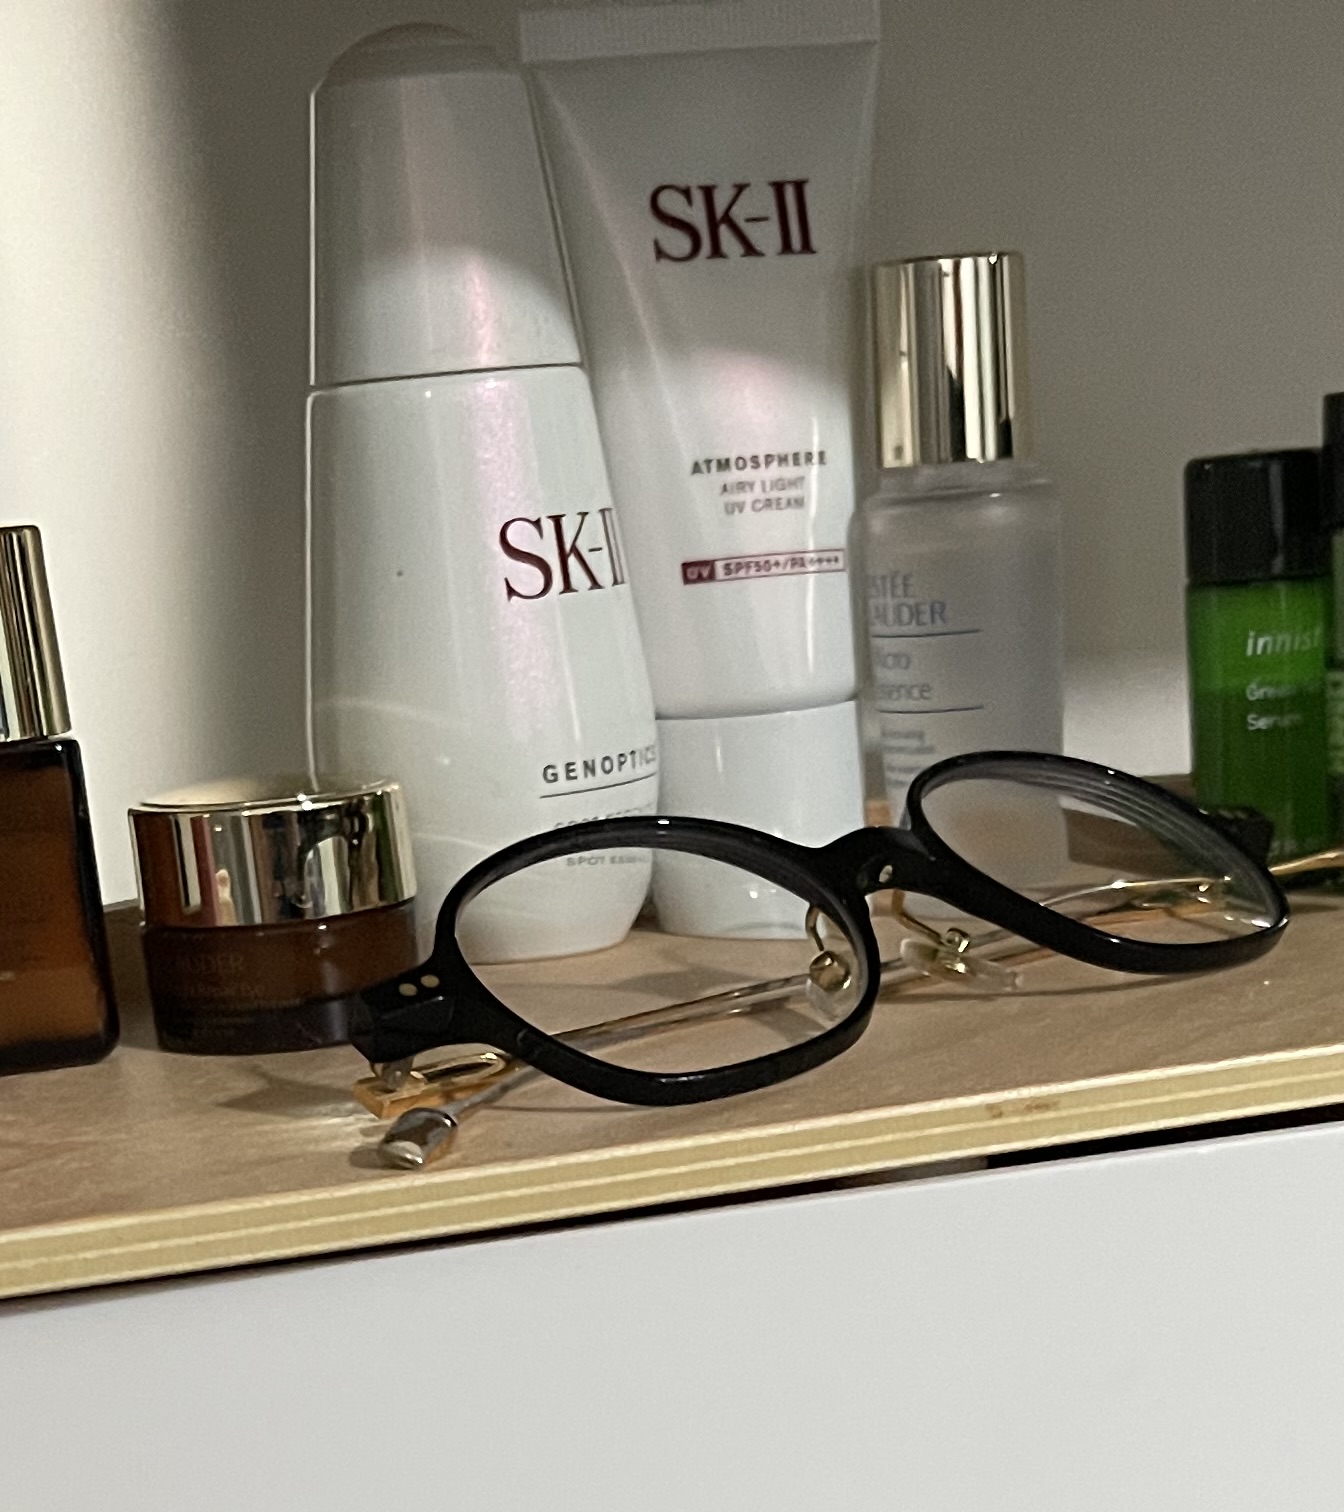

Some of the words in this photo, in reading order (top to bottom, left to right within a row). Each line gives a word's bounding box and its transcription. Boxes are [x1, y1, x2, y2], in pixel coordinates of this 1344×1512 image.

[649, 178, 817, 263] SK-II
[691, 450, 828, 475] ATMOSPHERE
[720, 480, 755, 496] AIRY
[760, 475, 806, 493] LIGHT
[723, 501, 746, 515] UV
[751, 496, 805, 513] CREAM
[871, 600, 946, 628] AUDER
